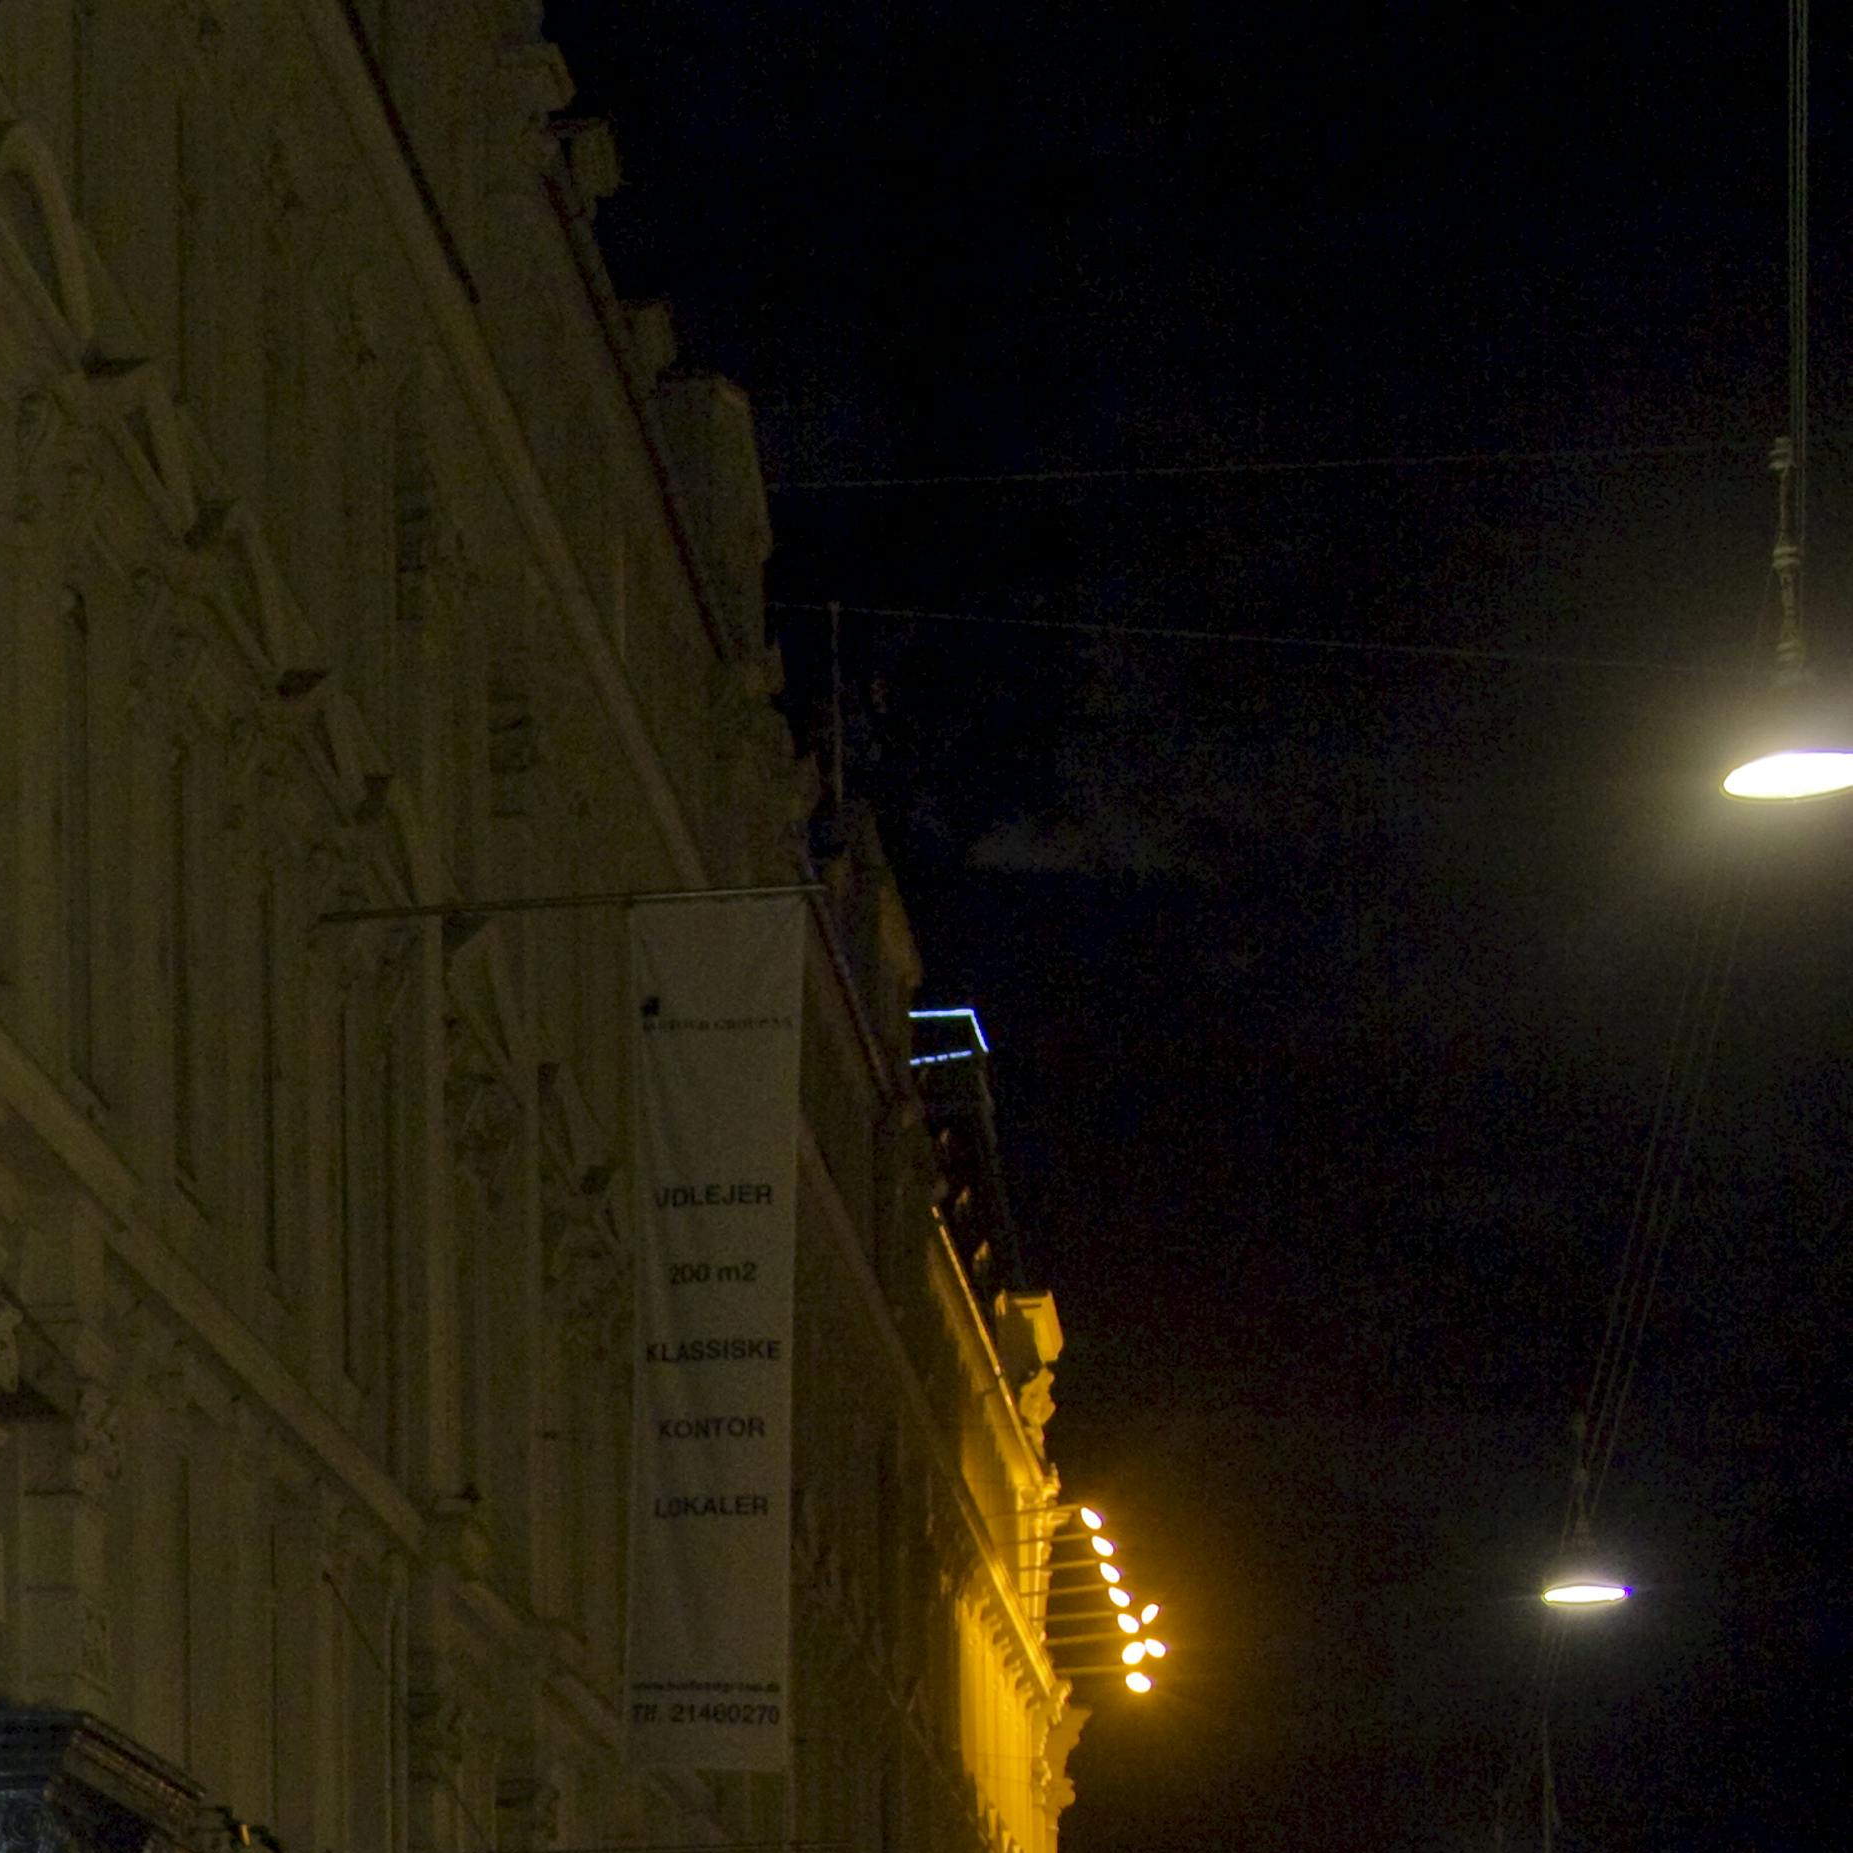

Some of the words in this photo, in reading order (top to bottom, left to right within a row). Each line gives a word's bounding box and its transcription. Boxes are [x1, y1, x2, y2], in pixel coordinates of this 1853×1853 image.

[653, 1183, 773, 1210] UDLEJER
[669, 1262, 711, 1286] 200
[717, 1260, 758, 1283] m2
[645, 1339, 782, 1364] KLASSISKE
[657, 1416, 767, 1440] KONTOR
[653, 1495, 770, 1520] LOKALER
